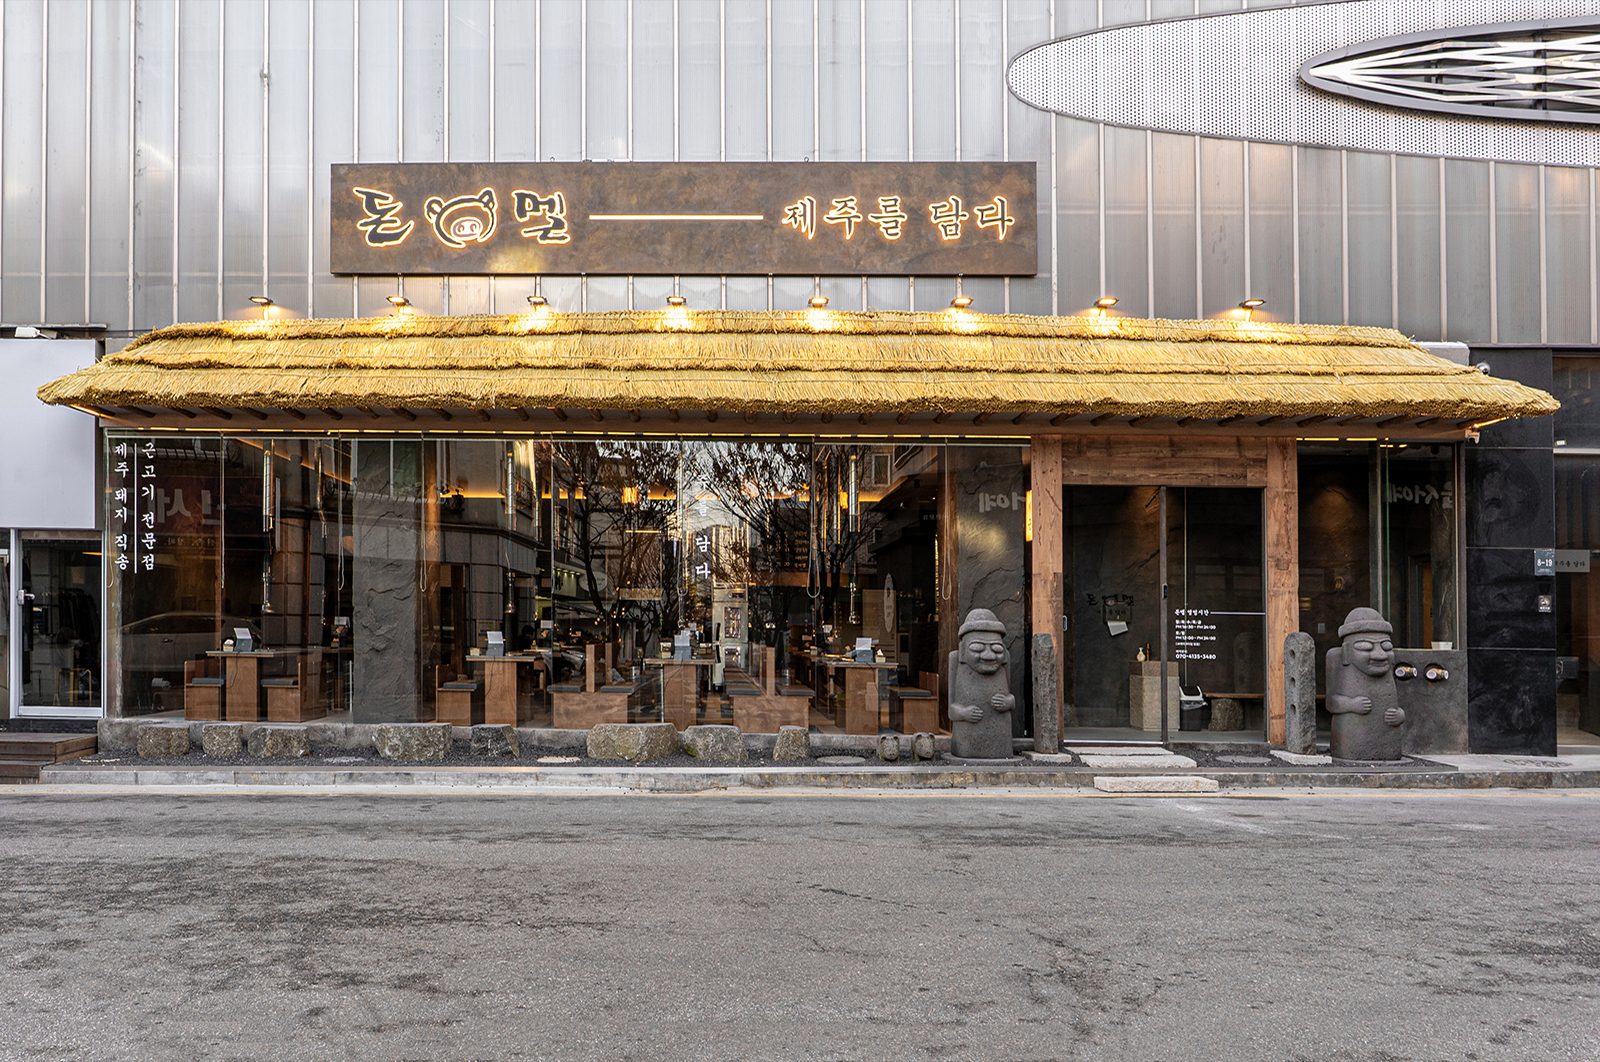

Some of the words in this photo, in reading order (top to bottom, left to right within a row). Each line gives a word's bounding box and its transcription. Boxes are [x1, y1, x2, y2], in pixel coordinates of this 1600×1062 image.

[352, 186, 415, 247] 돈
[781, 195, 908, 240] 제주를
[929, 195, 1016, 240] 담다
[114, 442, 130, 479] 제주
[141, 442, 157, 501] 근고기
[114, 487, 128, 524] 돼지
[114, 533, 130, 571] 직송
[141, 511, 157, 571] 전문점
[695, 534, 711, 579] 담다
[1537, 558, 1553, 567] 8-19
